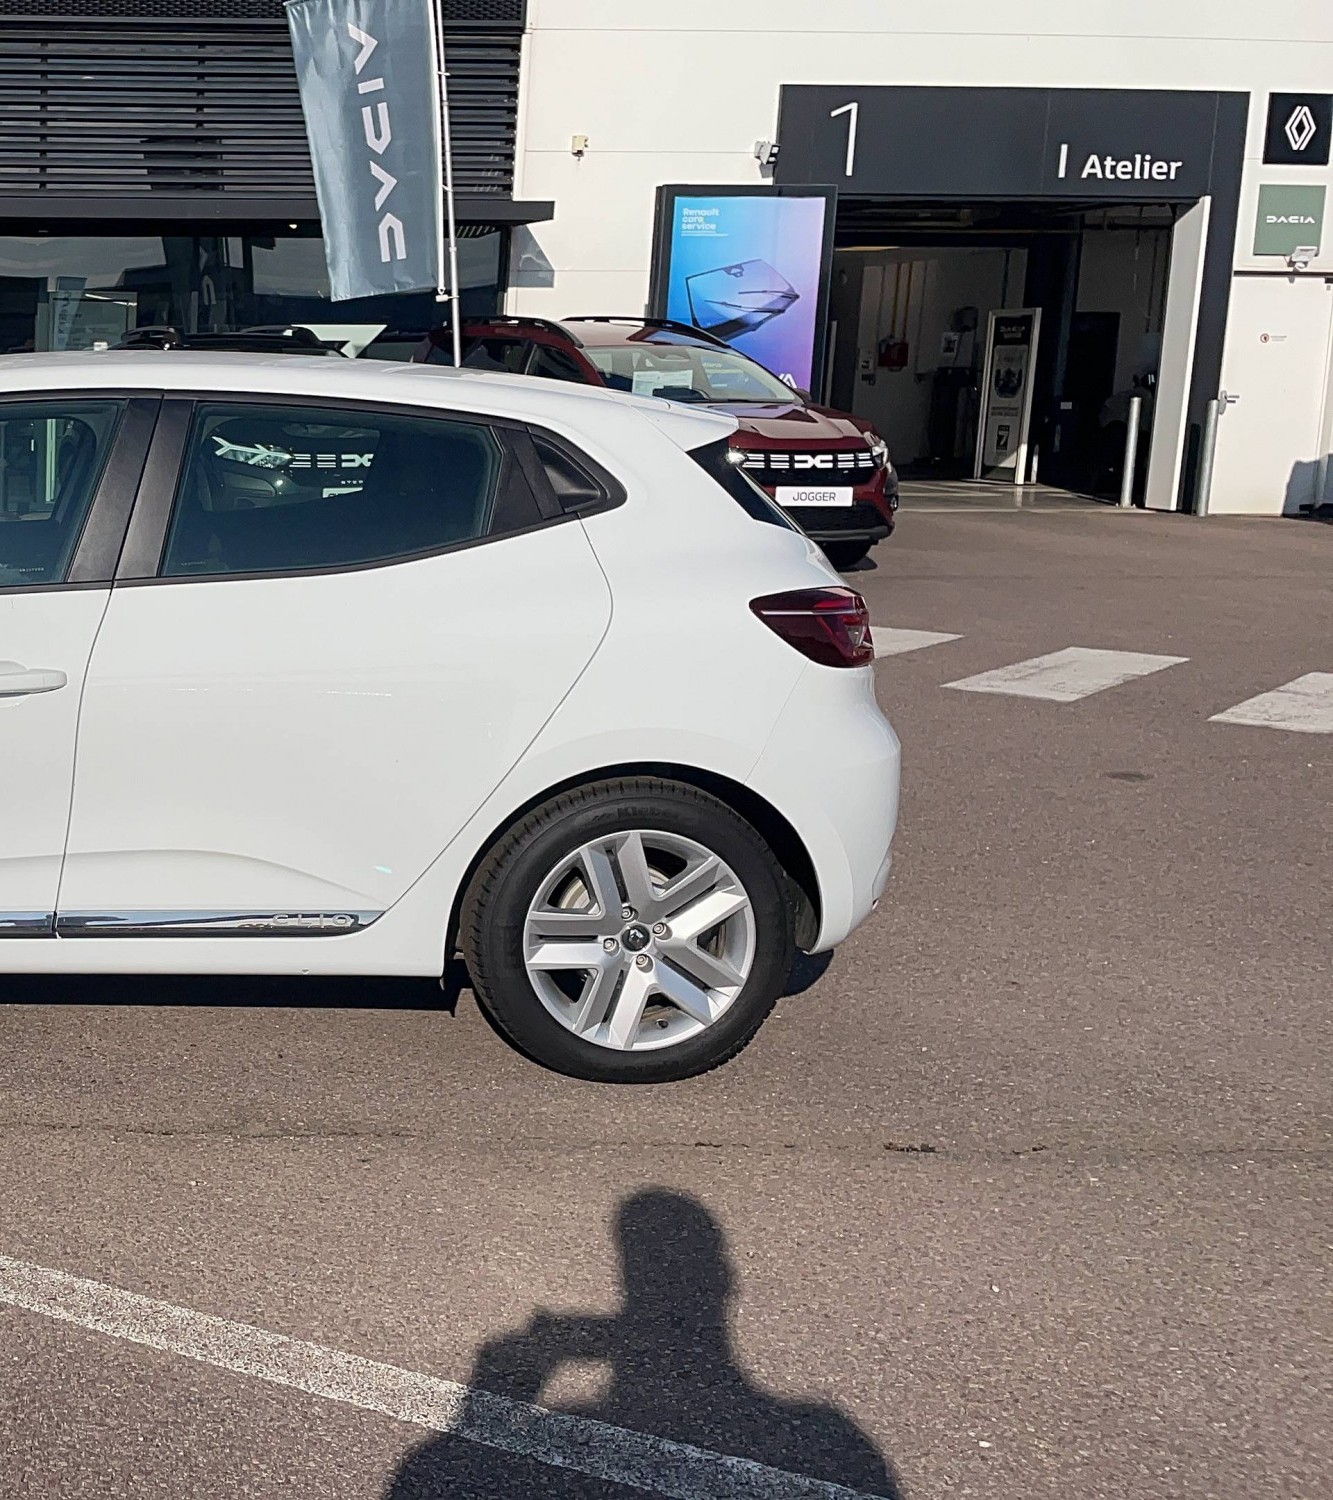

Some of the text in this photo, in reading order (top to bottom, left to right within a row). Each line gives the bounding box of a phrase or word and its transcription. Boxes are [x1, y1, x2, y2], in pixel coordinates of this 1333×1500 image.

[347, 22, 407, 263] DACIA
[830, 101, 858, 177] 1
[1080, 153, 1183, 181] Atelier
[682, 207, 720, 216] Renault
[682, 216, 704, 224] care
[1266, 215, 1316, 224] DACIA
[681, 223, 717, 231] service
[792, 491, 837, 502] JOGGER
[272, 913, 352, 927] CLIO
